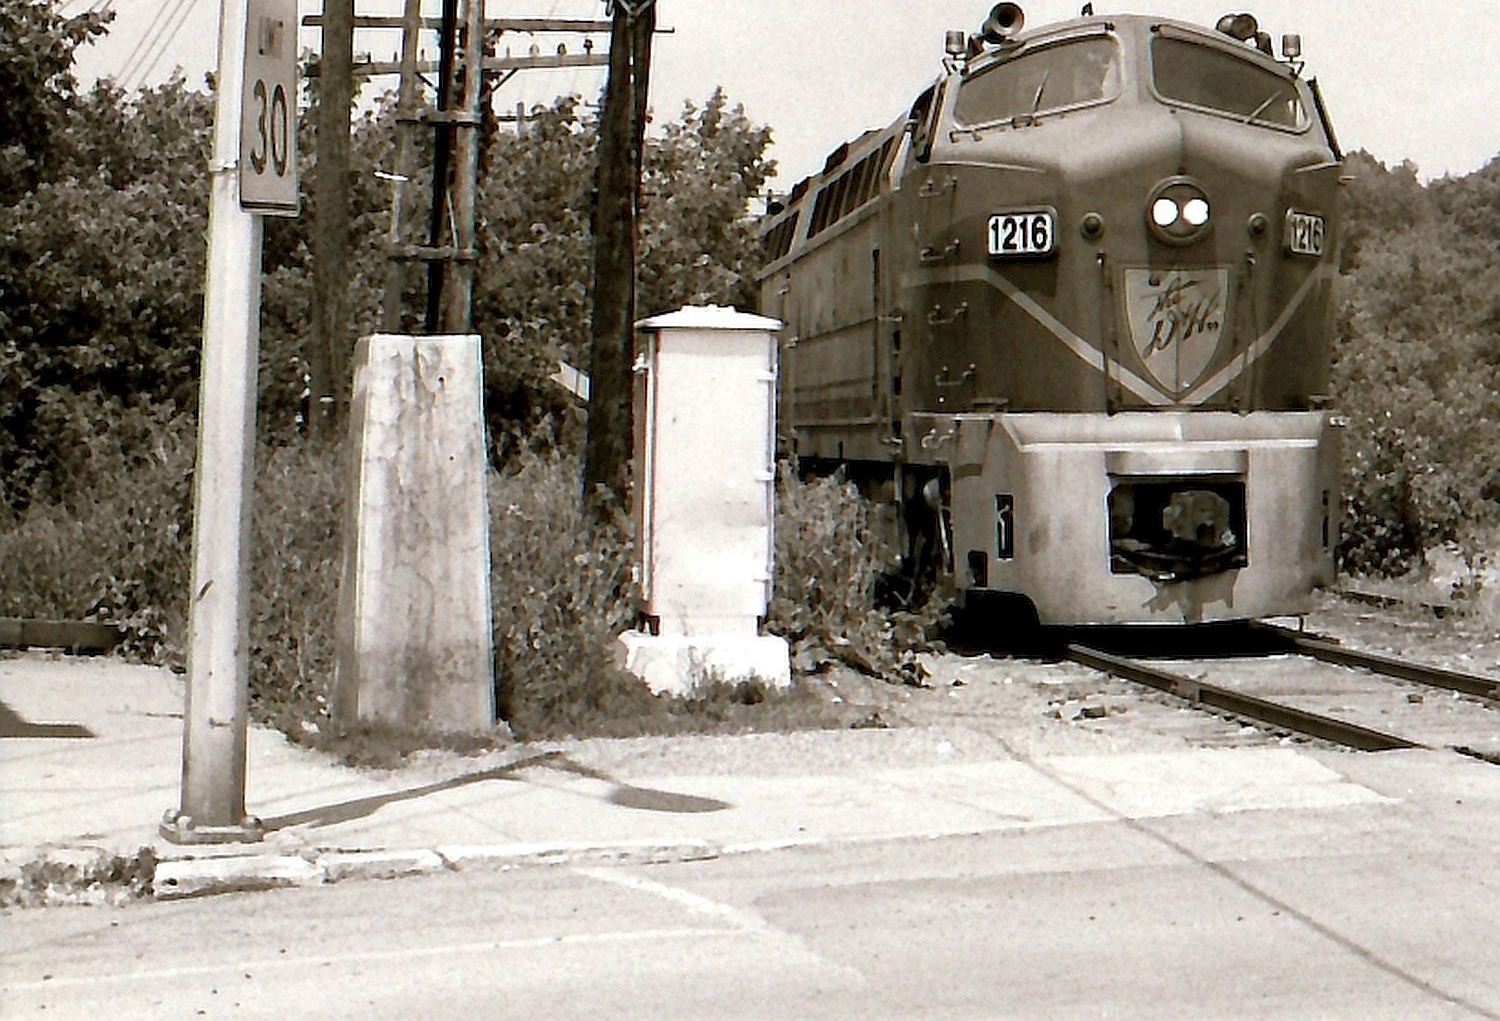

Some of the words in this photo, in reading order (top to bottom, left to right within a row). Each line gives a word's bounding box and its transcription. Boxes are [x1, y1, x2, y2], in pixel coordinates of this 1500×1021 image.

[250, 79, 289, 178] 30
[991, 216, 1048, 250] 1216
[1292, 217, 1322, 251] 1216
